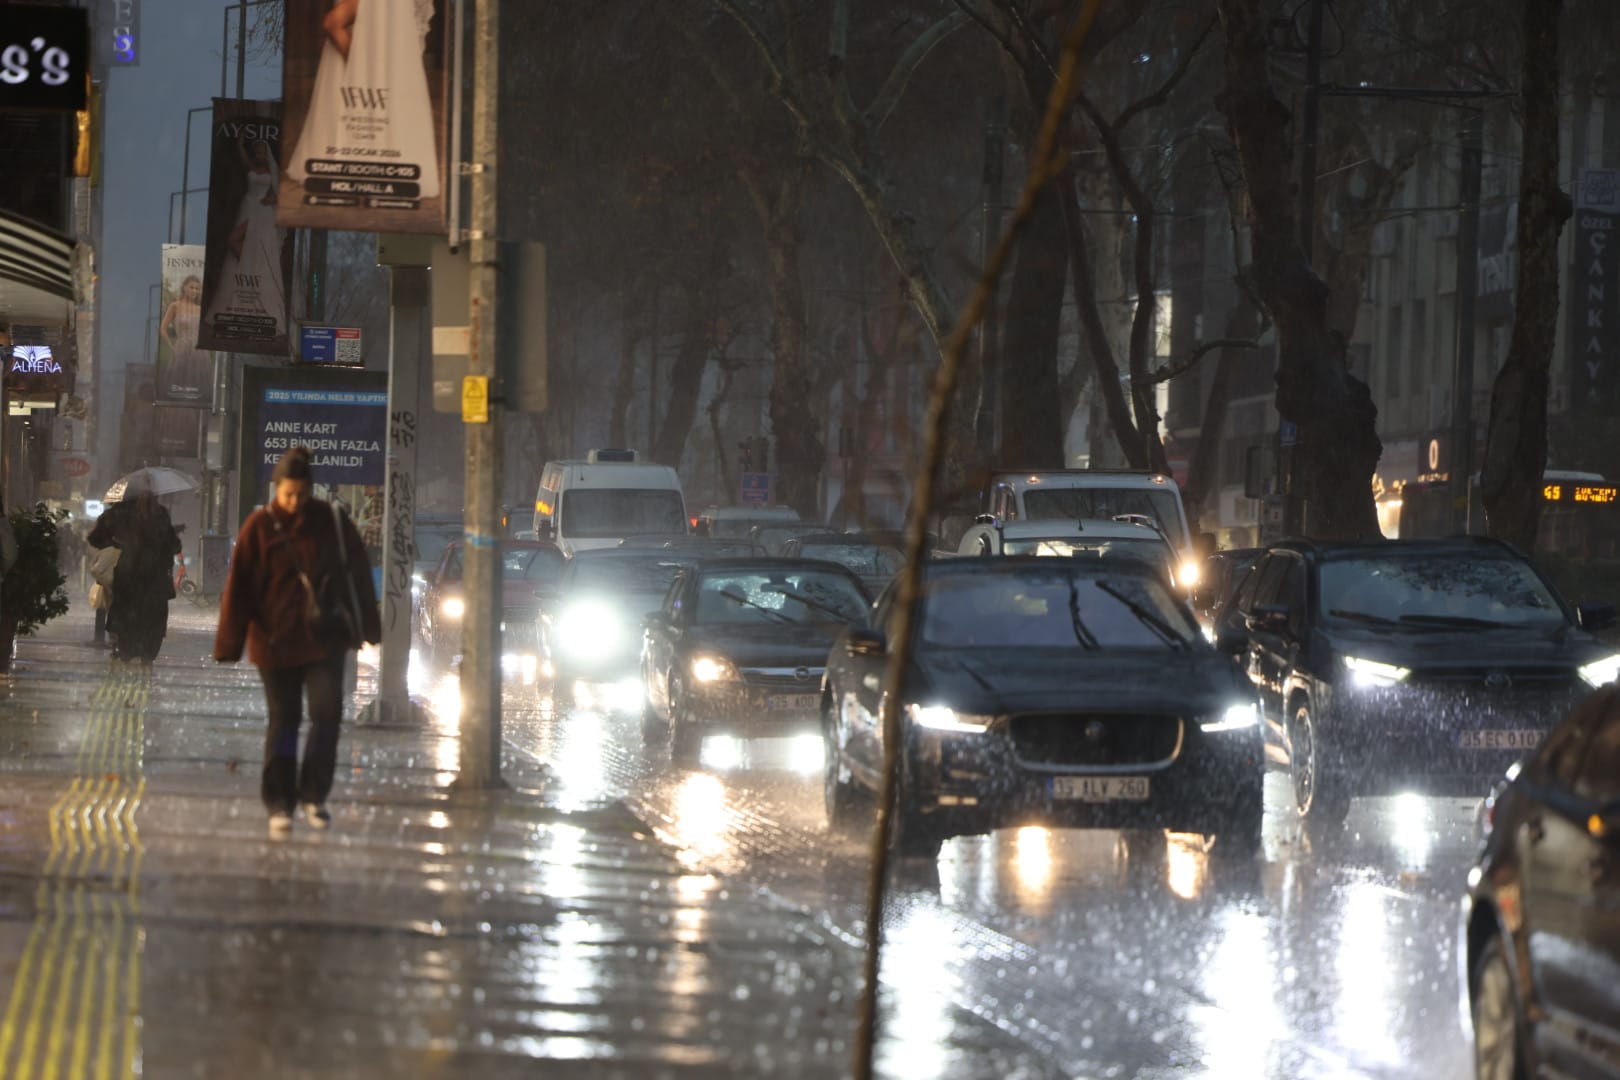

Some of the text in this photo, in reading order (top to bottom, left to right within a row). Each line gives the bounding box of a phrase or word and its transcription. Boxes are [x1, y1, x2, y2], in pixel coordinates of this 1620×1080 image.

[340, 86, 390, 110] IFWF
[269, 391, 290, 400] 2025
[292, 391, 326, 401] YILINDA
[328, 393, 354, 402] NELER
[264, 421, 338, 434] ANNE KART
[264, 436, 380, 452] 653 BİNDEN FAZLA
[1463, 731, 1481, 746] 35
[1485, 731, 1504, 746] EC
